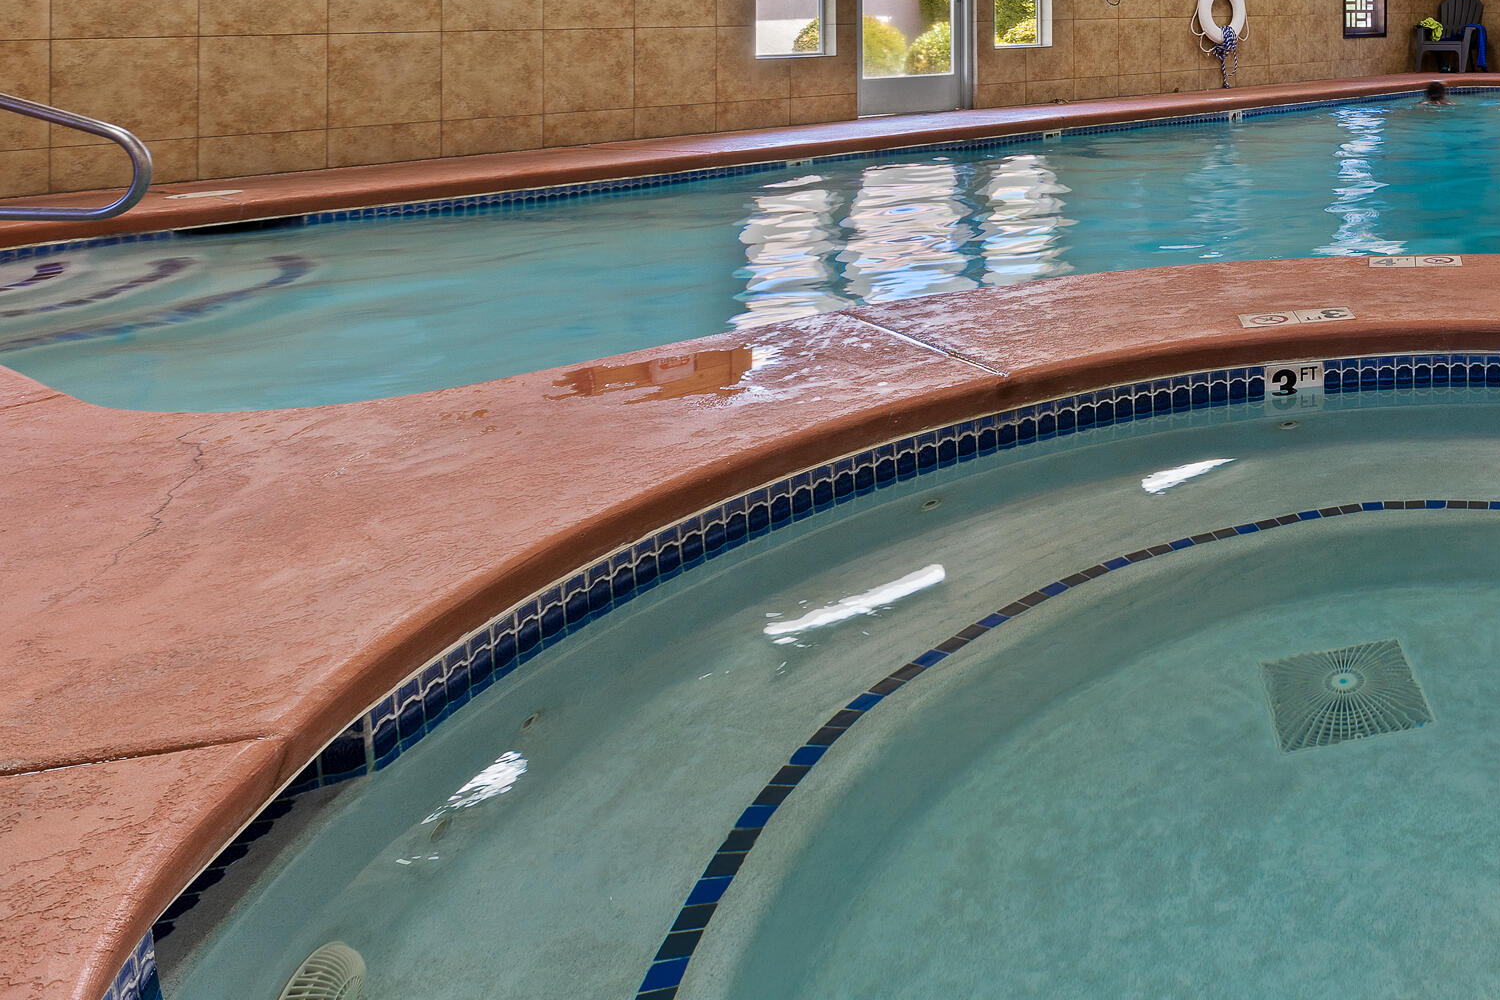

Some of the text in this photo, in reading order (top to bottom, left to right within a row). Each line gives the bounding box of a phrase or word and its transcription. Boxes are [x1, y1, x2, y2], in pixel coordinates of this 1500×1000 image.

[1320, 309, 1348, 319] 3
[1272, 366, 1318, 396] 3 FT
